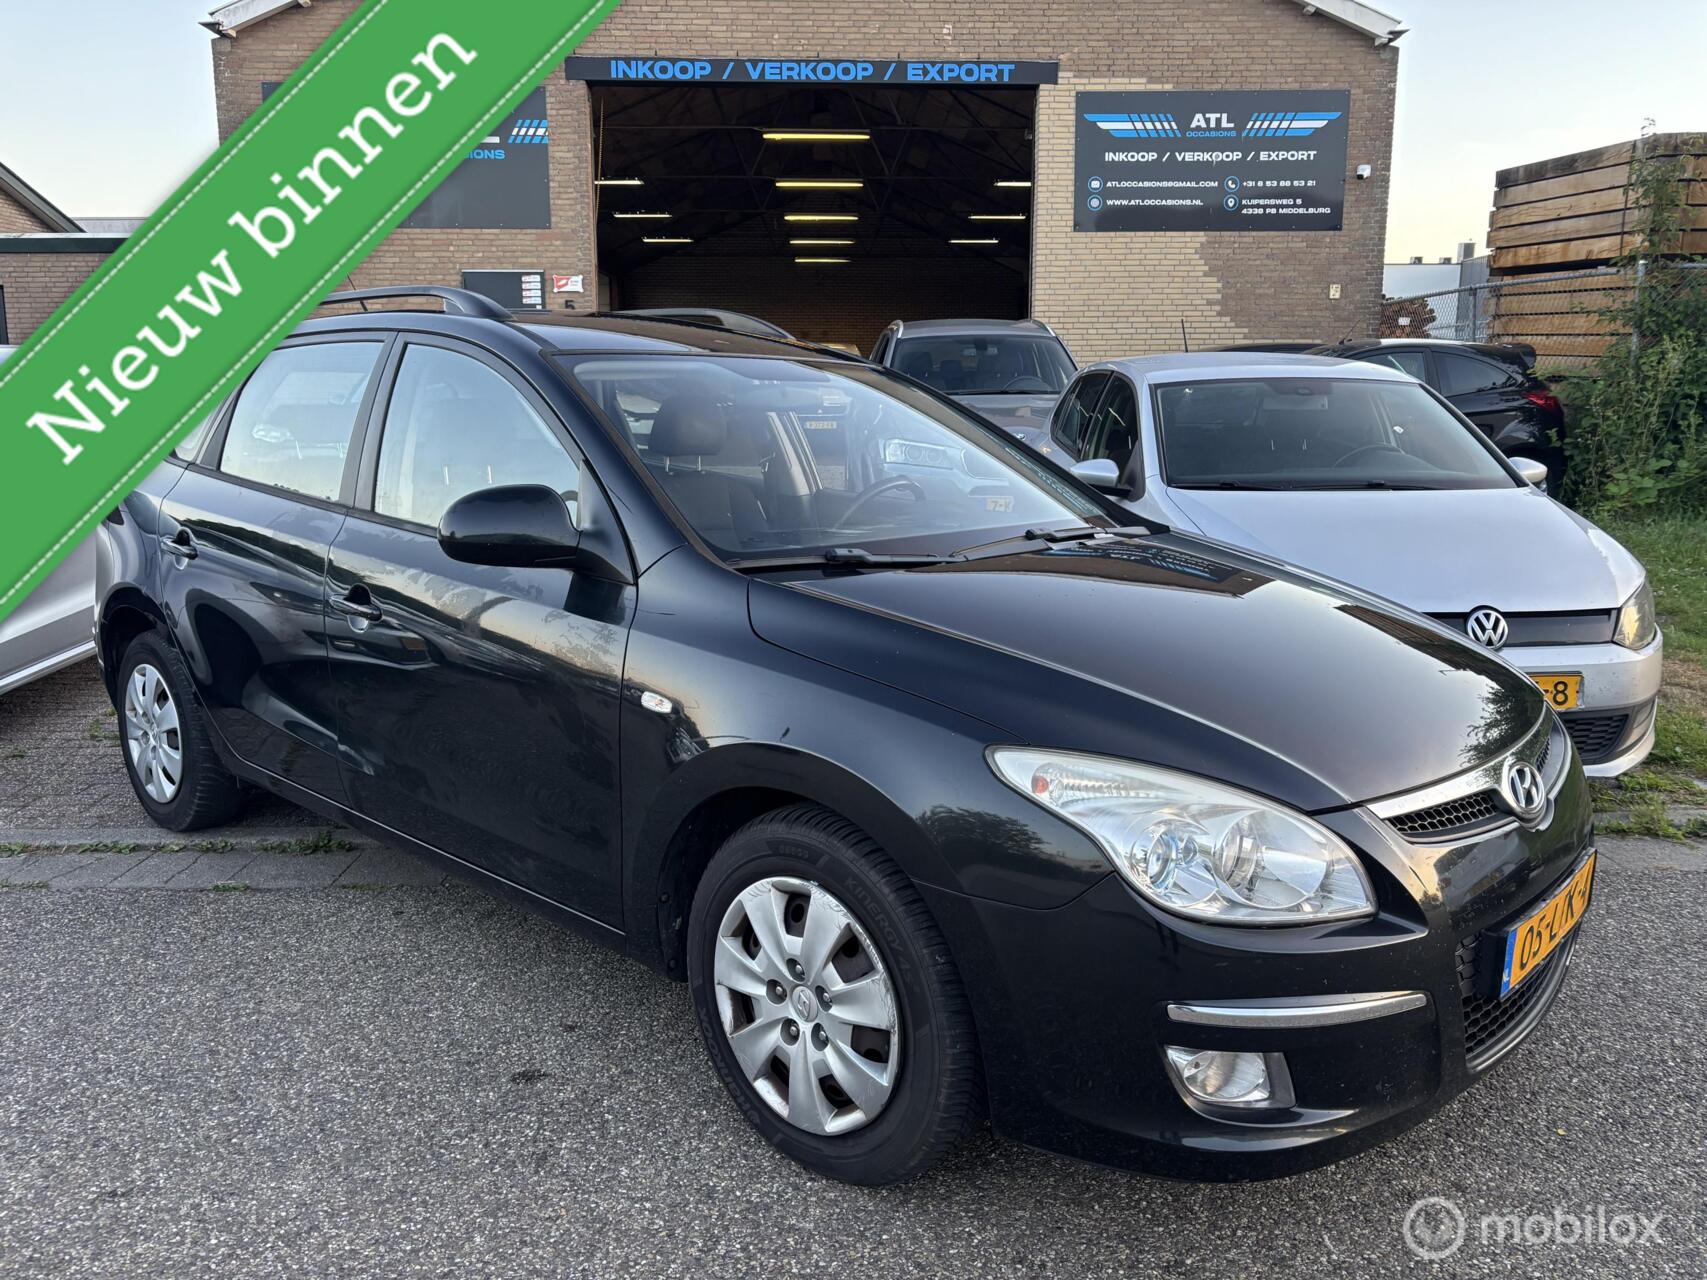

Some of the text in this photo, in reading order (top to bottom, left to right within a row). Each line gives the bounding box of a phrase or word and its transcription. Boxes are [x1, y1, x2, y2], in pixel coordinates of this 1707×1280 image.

[609, 60, 1016, 82] INKOOP / VERKOOP / EXPORT
[1189, 113, 1235, 128] ATL
[1185, 130, 1237, 138] OCCASIONS
[1104, 151, 1158, 162] INKOOP
[1161, 151, 1171, 163] /
[1174, 151, 1243, 163] VERKOOP
[1259, 150, 1318, 162] EXPORT
[1241, 198, 1294, 206] KUIPERSWEG
